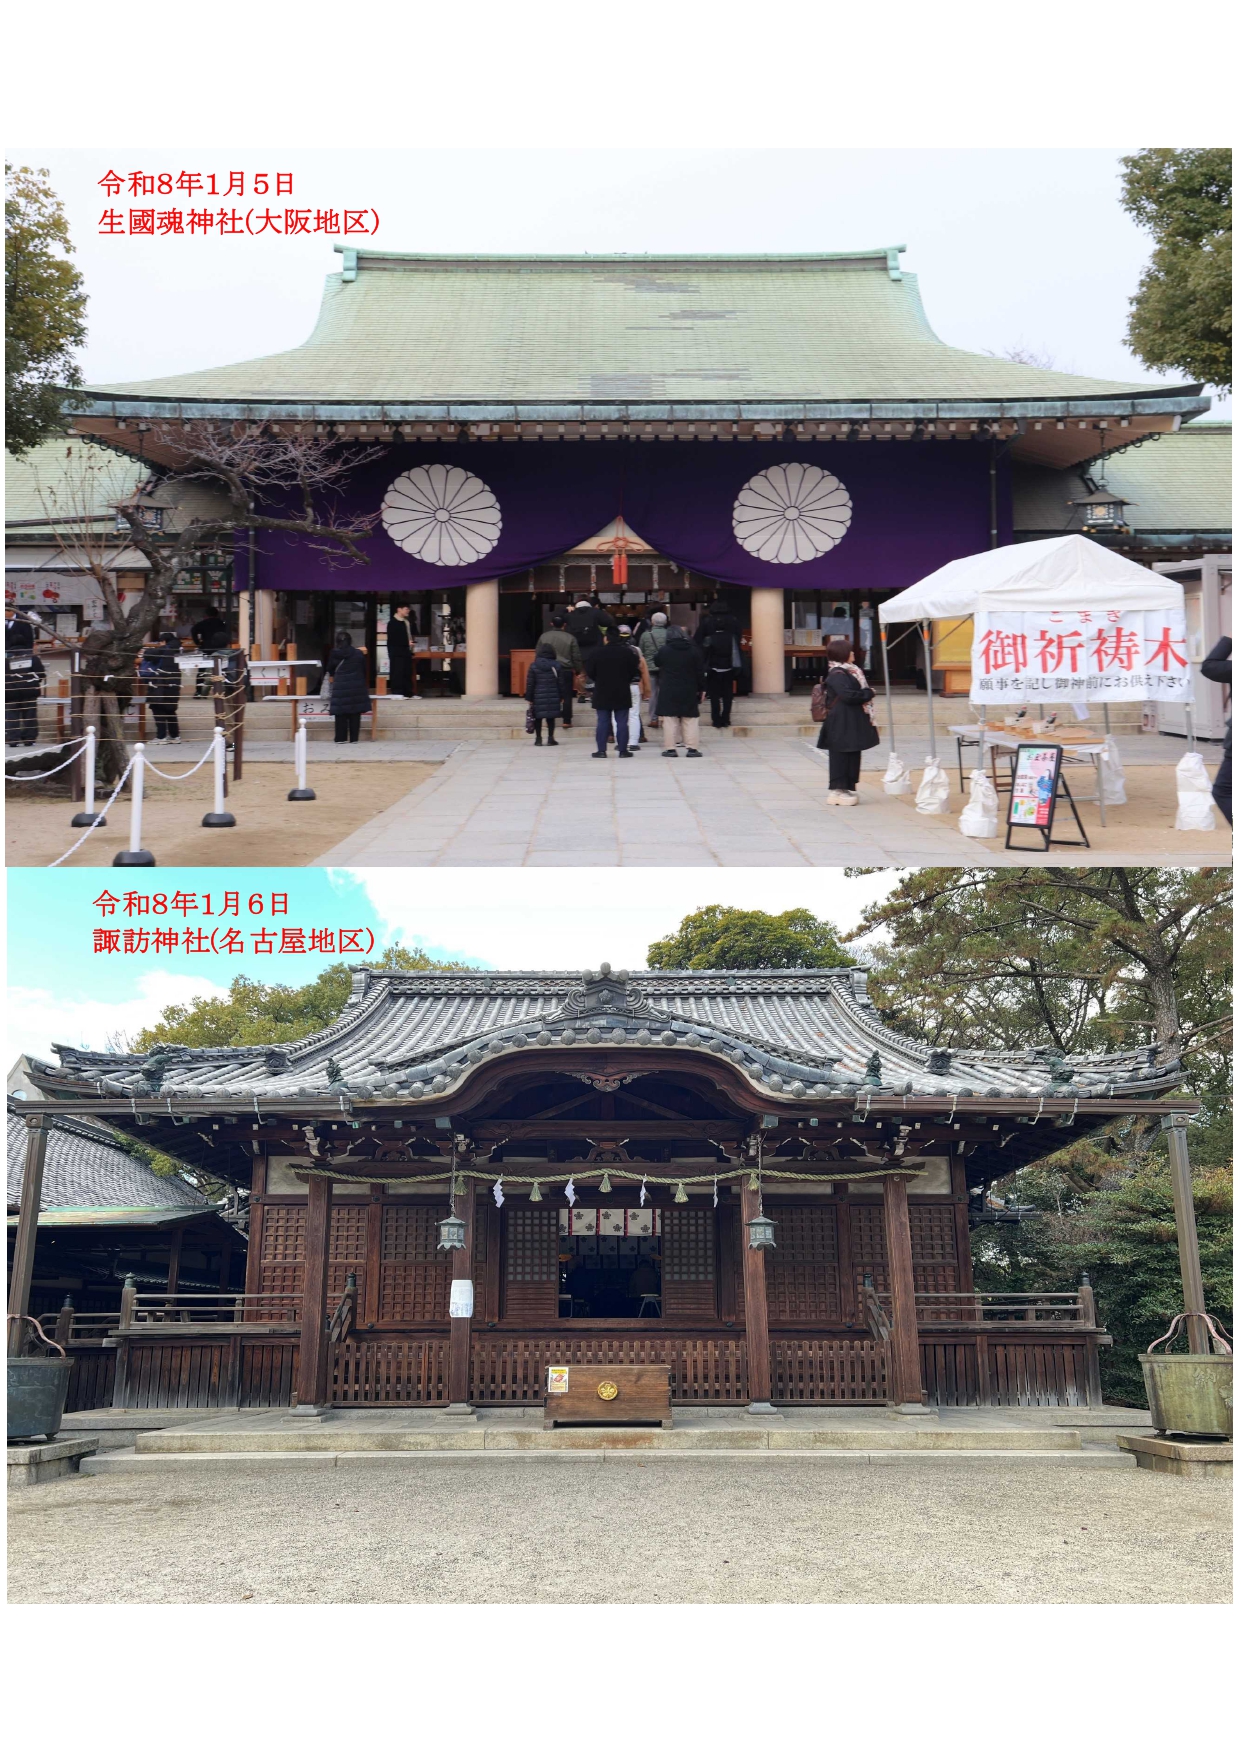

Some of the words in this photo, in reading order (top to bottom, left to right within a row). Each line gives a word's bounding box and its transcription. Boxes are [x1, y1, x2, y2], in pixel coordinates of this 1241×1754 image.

[978, 627, 1189, 675] 御祈祷木
[979, 674, 1190, 691] 願事を記し御神前にお供え下さい
